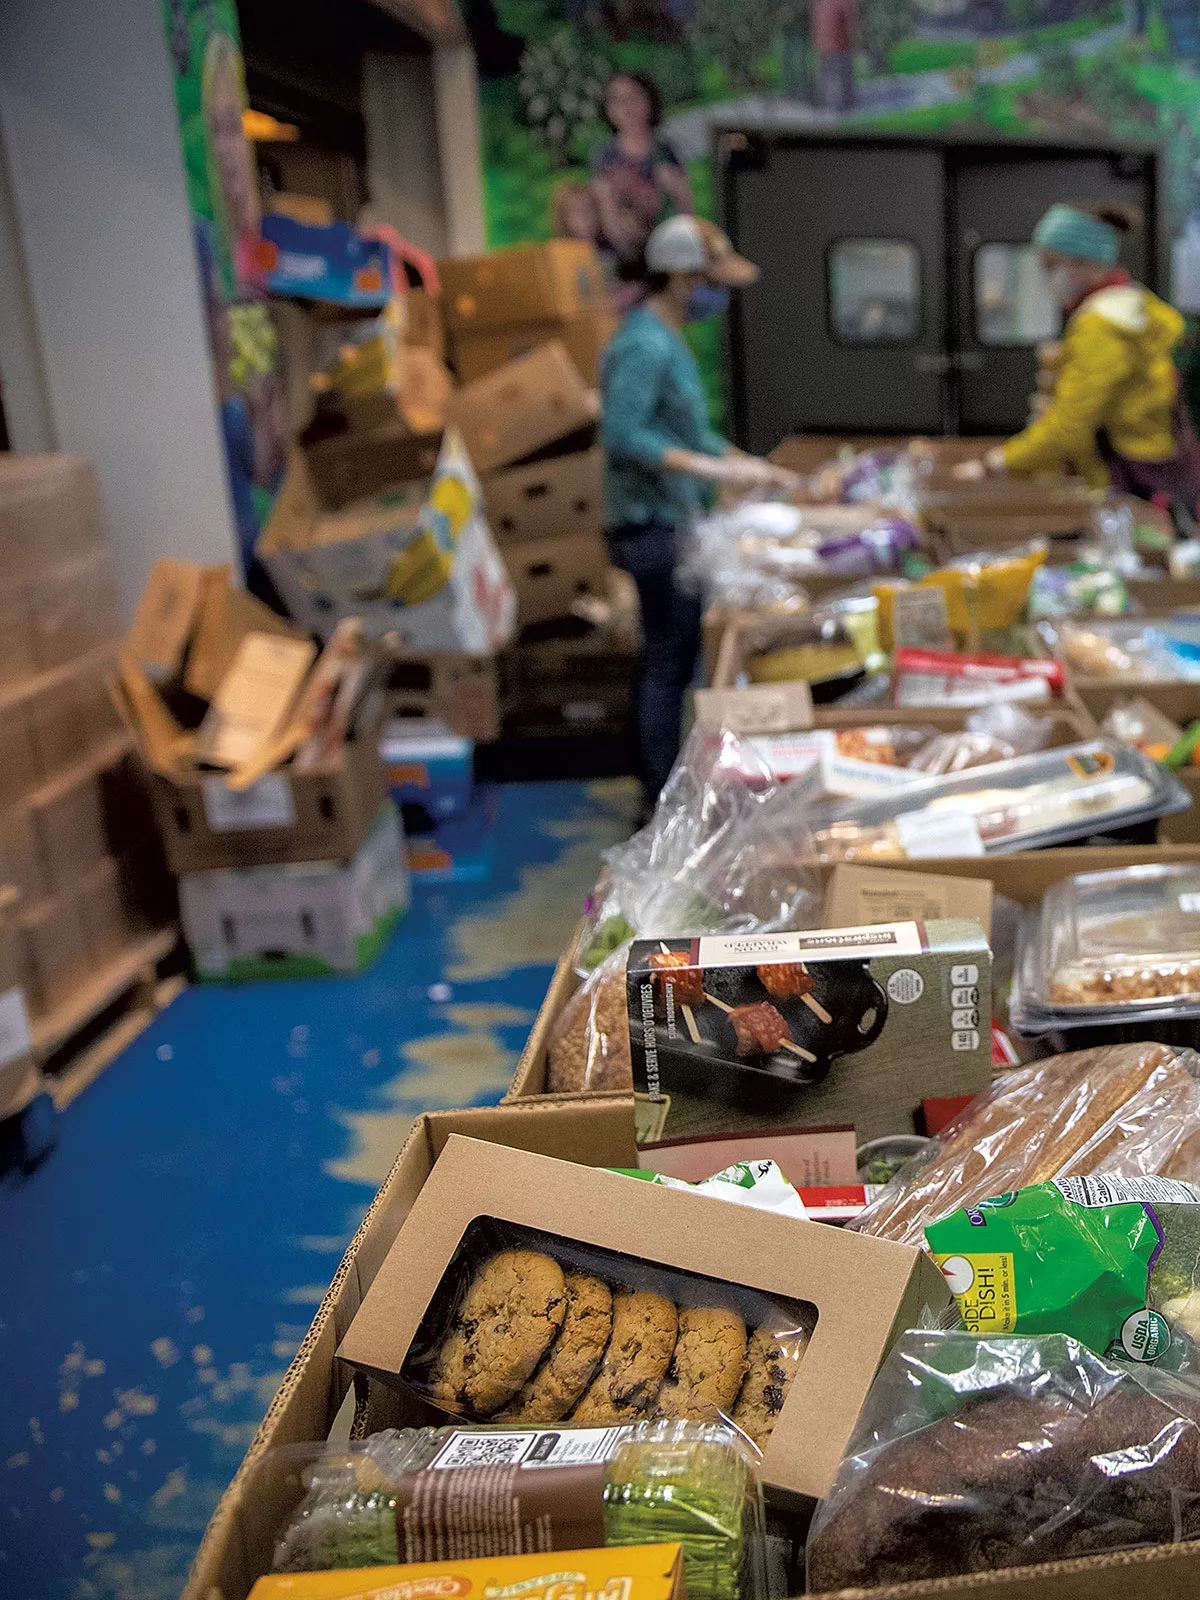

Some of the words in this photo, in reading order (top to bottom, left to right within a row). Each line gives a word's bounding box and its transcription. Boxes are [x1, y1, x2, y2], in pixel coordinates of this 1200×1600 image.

[640, 984, 655, 1025] D'OEUVRES
[666, 983, 675, 1022] THOROUGHLY
[644, 1028, 656, 1048] HORS
[667, 1023, 676, 1039] COOK
[645, 1049, 659, 1072] SERVE
[647, 1081, 660, 1100] BAKE
[999, 1255, 1007, 1268] less!
[1002, 1269, 1008, 1277] or
[977, 1267, 995, 1319] DISH!
[964, 1299, 979, 1332] SIDE
[1130, 1318, 1148, 1349] USDA
[1146, 1316, 1158, 1354] ORGANIC
